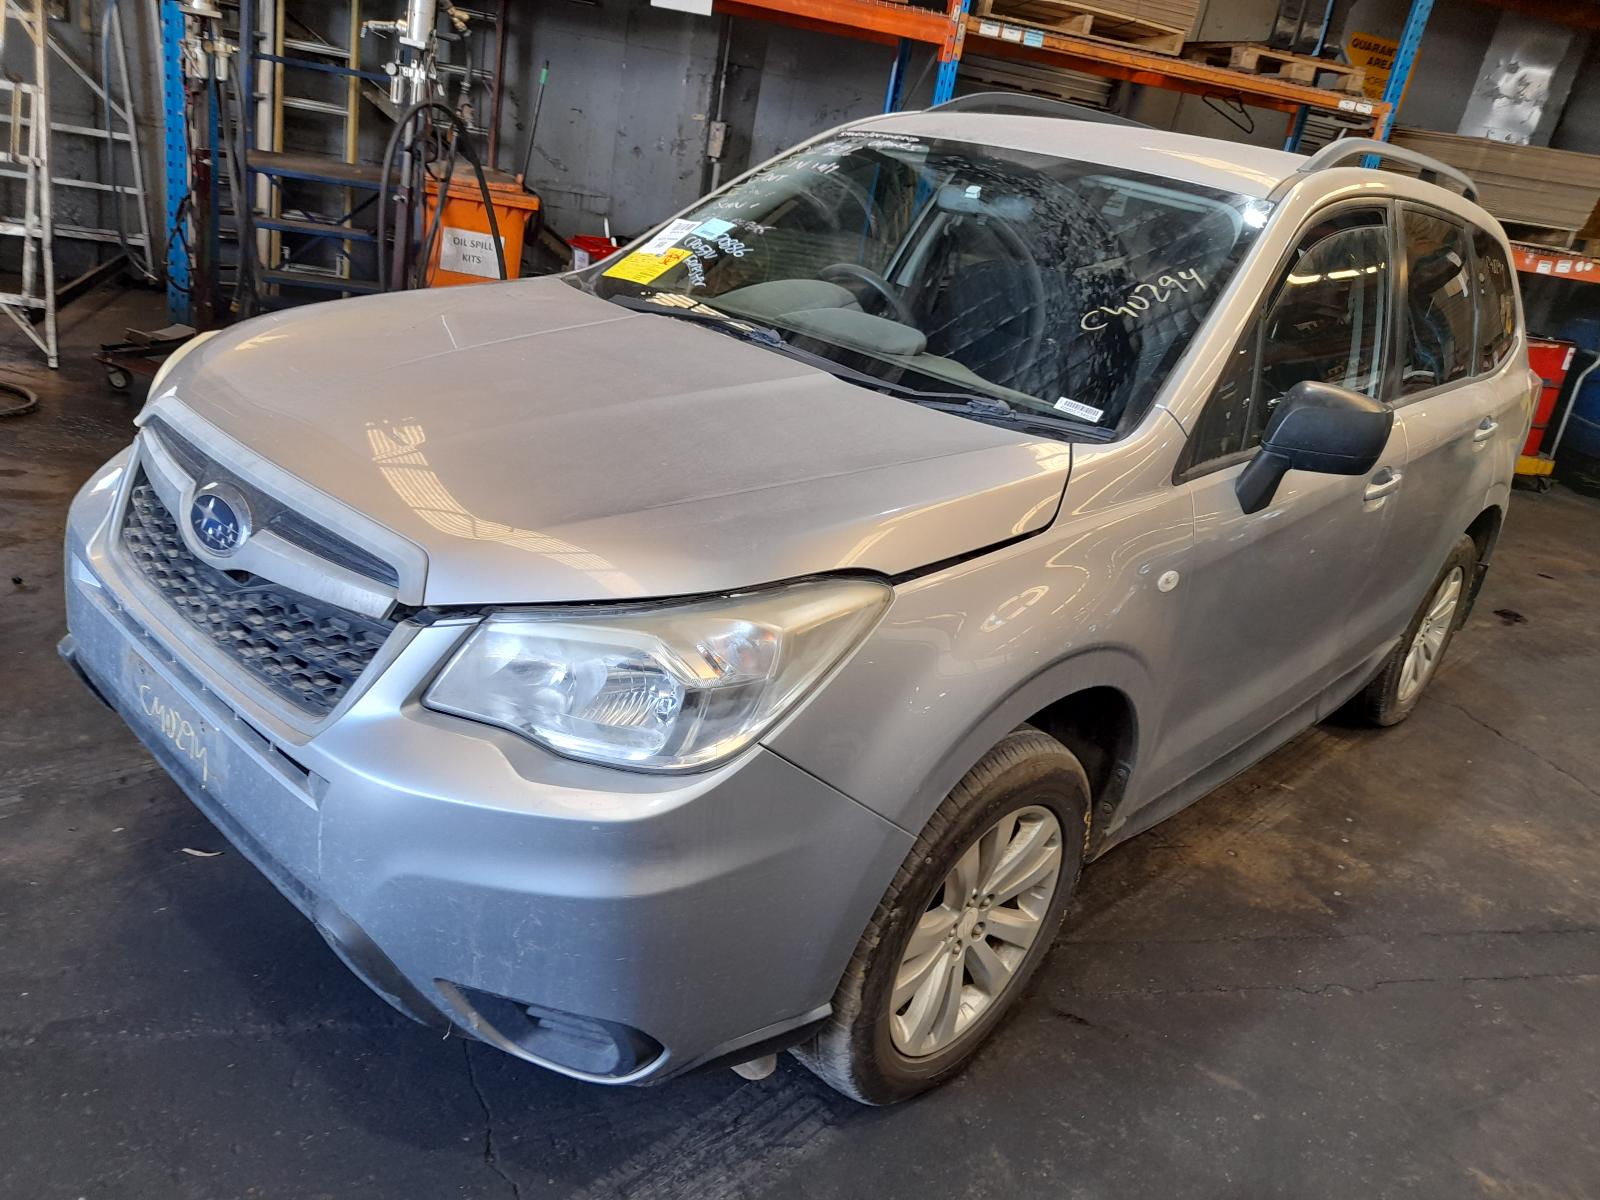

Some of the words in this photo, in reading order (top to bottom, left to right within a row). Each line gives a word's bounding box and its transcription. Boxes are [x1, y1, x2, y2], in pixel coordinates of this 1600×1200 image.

[453, 236, 467, 247] OIL
[470, 240, 493, 251] SPILL
[462, 254, 482, 264] KITS
